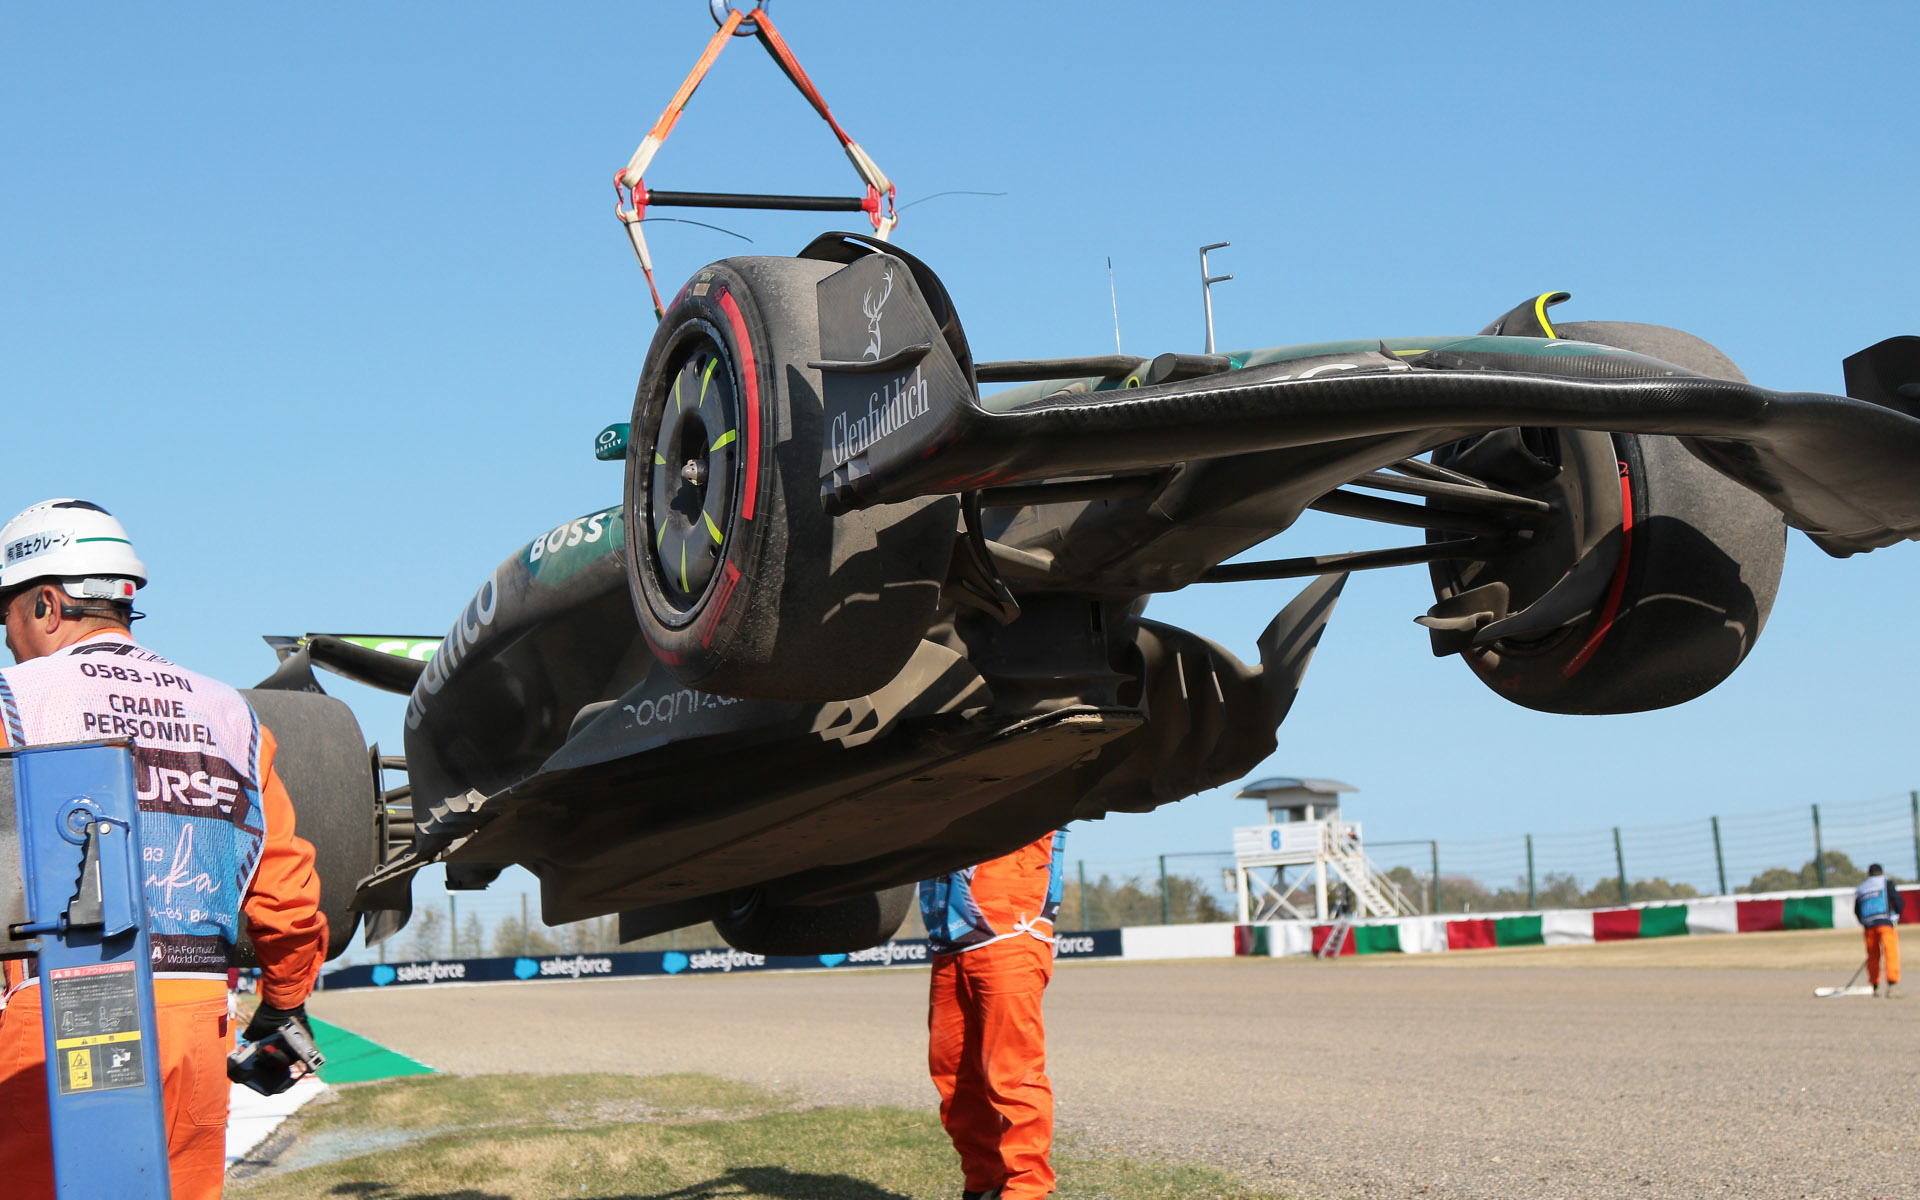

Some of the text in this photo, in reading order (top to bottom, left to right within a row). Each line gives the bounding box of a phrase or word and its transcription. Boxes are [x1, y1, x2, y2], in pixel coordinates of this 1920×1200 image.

[831, 363, 930, 466] Glenfiddich
[596, 438, 622, 454] OAKLEY
[530, 512, 608, 563] BOSS
[80, 663, 193, 693] 0583-JPN
[108, 693, 186, 719] CRANE
[83, 712, 217, 746] PERSONNEL
[1270, 829, 1282, 851] 8
[540, 955, 613, 979] salesforce
[690, 947, 766, 972] salesforce
[397, 961, 466, 984] salesforce
